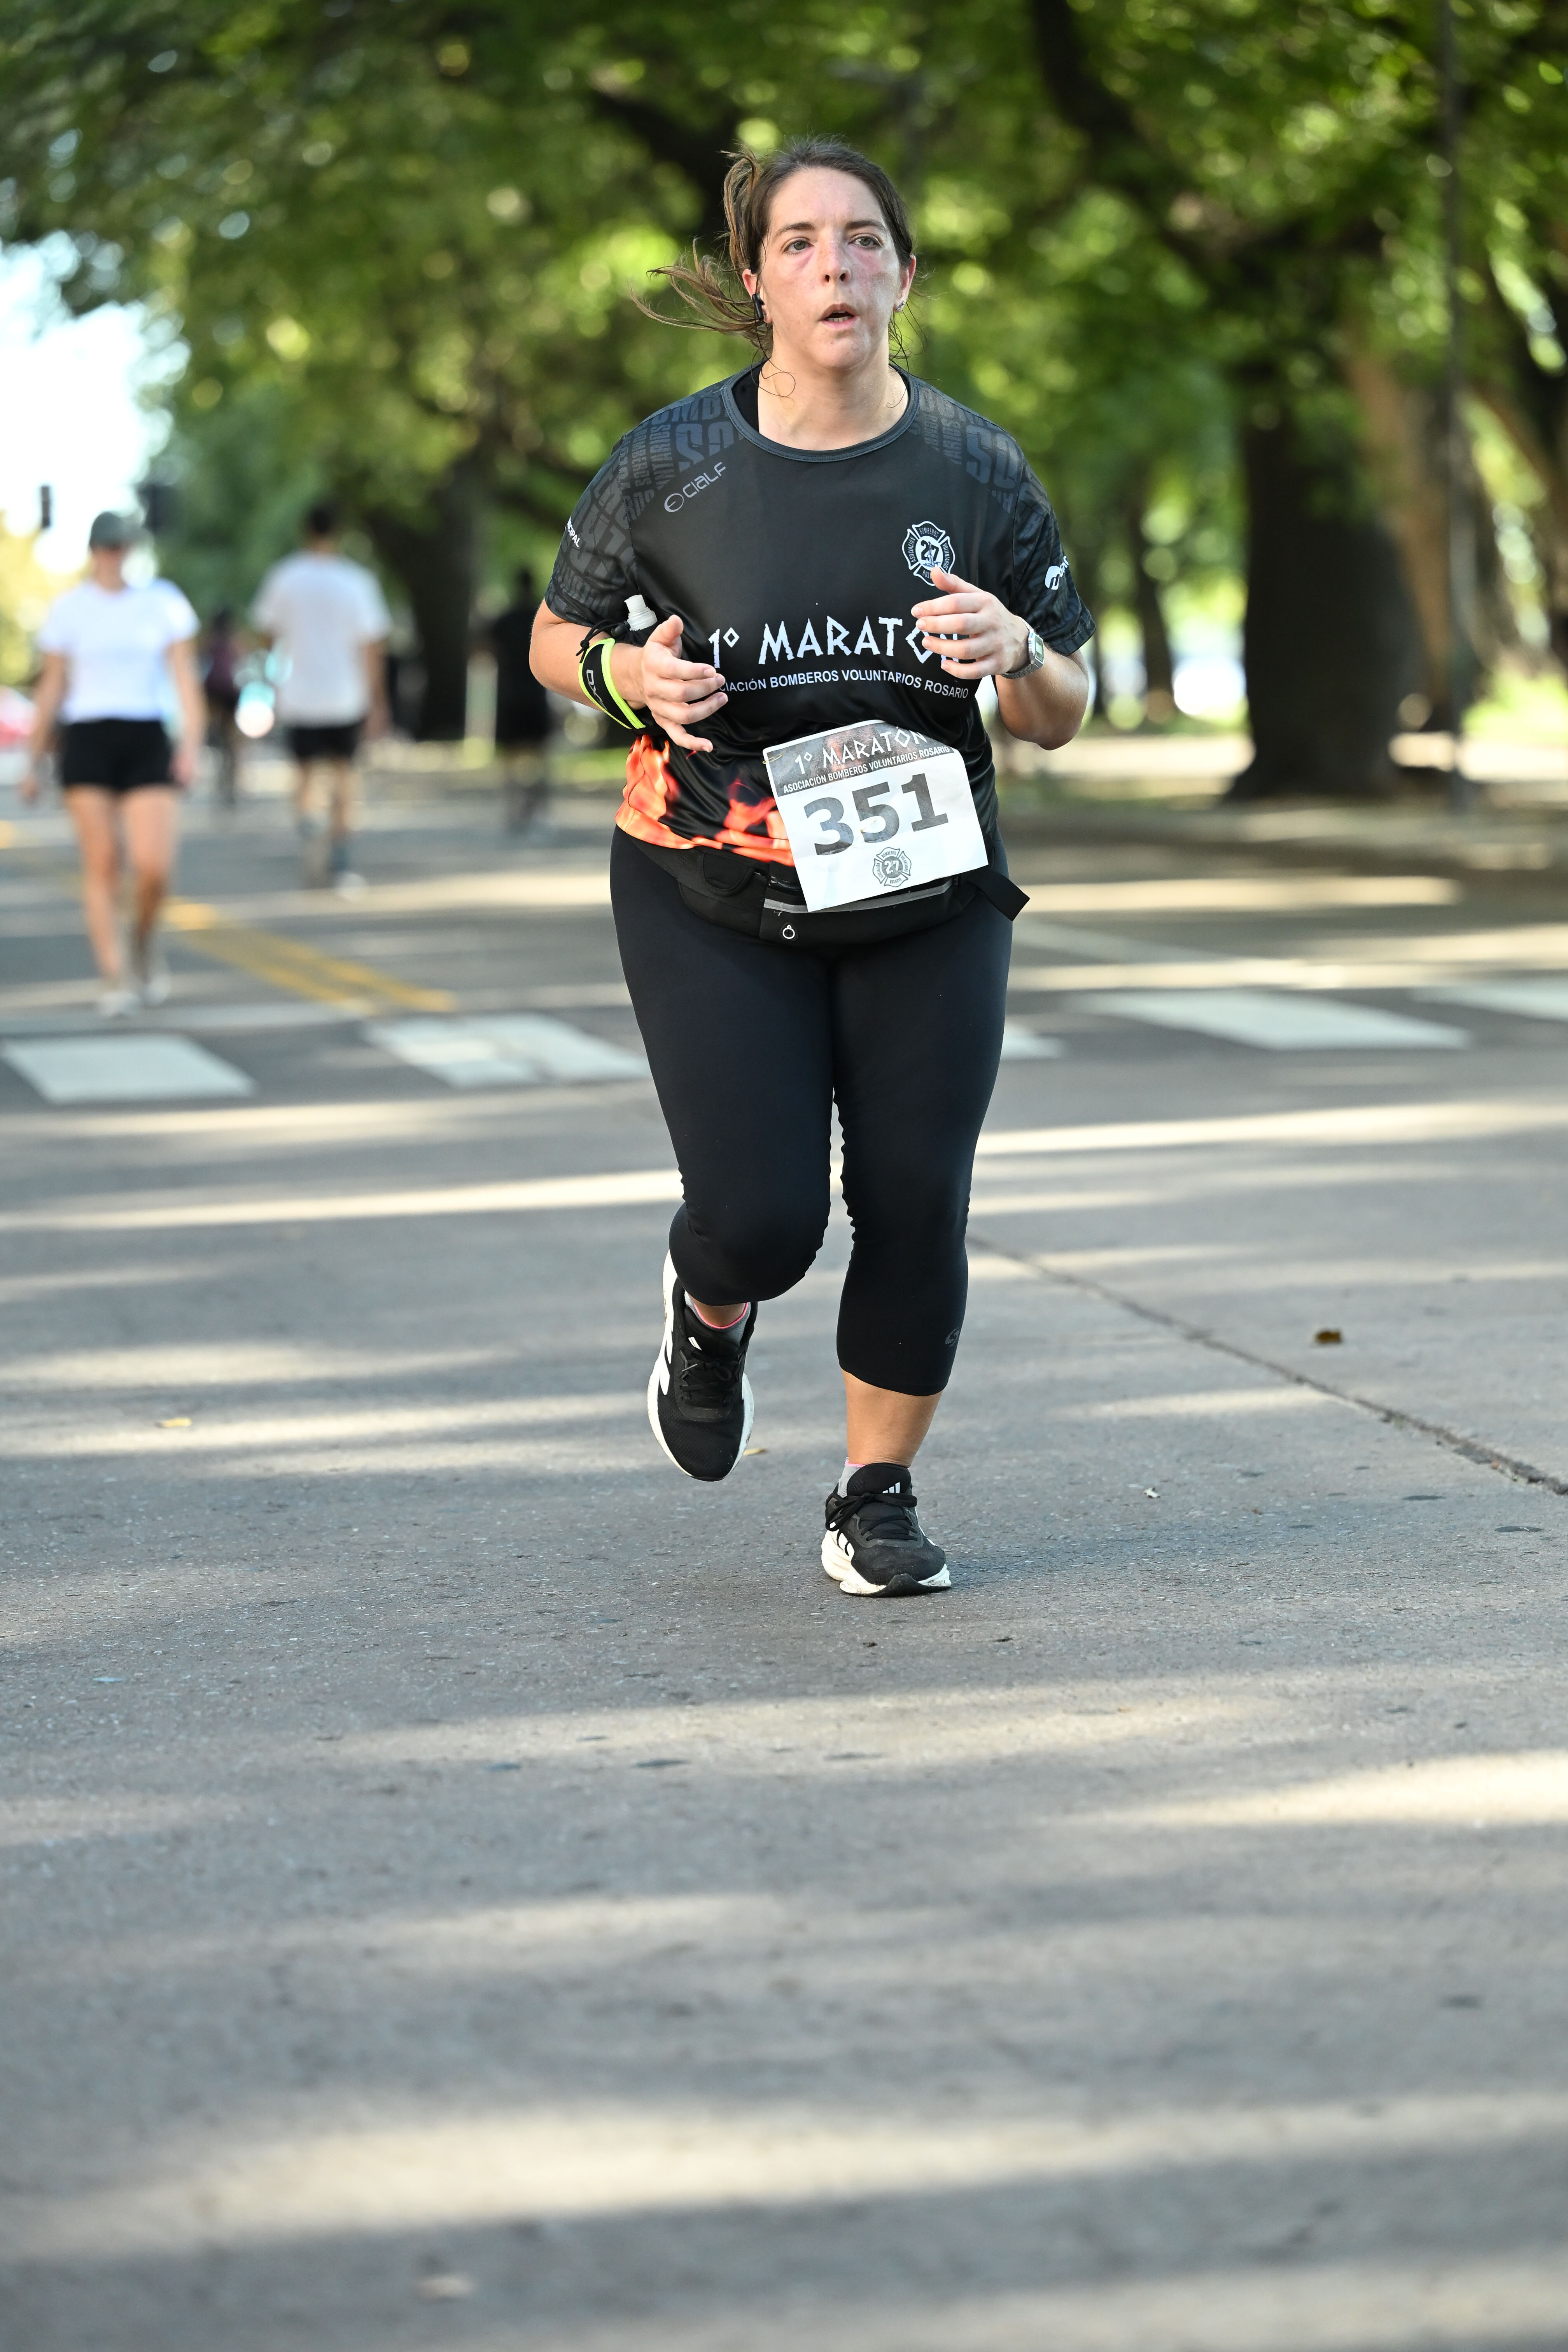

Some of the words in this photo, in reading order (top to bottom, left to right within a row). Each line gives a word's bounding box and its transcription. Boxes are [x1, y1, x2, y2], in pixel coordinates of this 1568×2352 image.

[919, 527, 939, 538] BOMBEROS
[719, 678, 767, 692] CIACIÓN
[770, 670, 839, 688] BOMBEROS
[842, 669, 922, 688] VOLUNTARIOS
[924, 680, 969, 699] ROSARIO
[784, 774, 827, 794] ASOCIACIÓN
[828, 764, 868, 781] BOMBEROS
[869, 751, 918, 770] VOLUNTARIOS
[919, 746, 950, 758] ROSARIO
[803, 773, 949, 856] 351
[884, 860, 899, 874] 27
